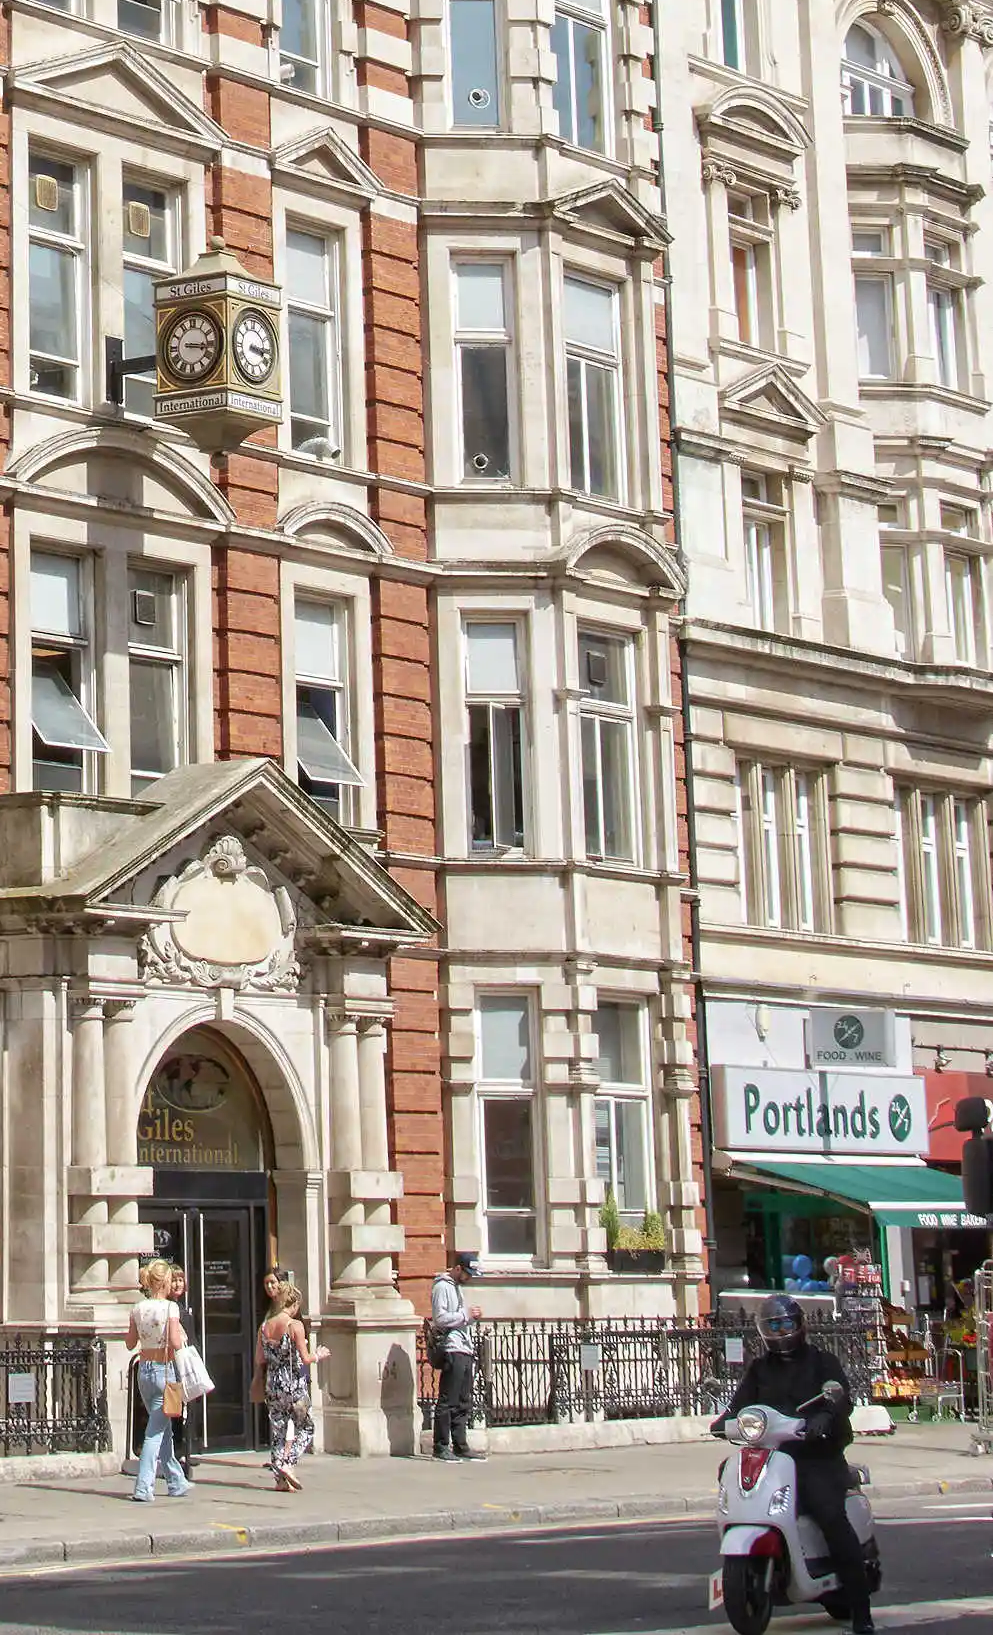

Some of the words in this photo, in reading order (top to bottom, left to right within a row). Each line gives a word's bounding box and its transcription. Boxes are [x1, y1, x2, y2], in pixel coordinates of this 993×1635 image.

[170, 286, 180, 298] St
[184, 282, 212, 295] Giles
[248, 284, 269, 299] Giles
[160, 393, 223, 412] International
[231, 393, 279, 415] International
[817, 1050, 847, 1061] FOOD
[855, 1050, 882, 1061] WINE
[744, 1083, 881, 1140] Portlands
[137, 1108, 195, 1142] Giles
[138, 1142, 239, 1165] nternational
